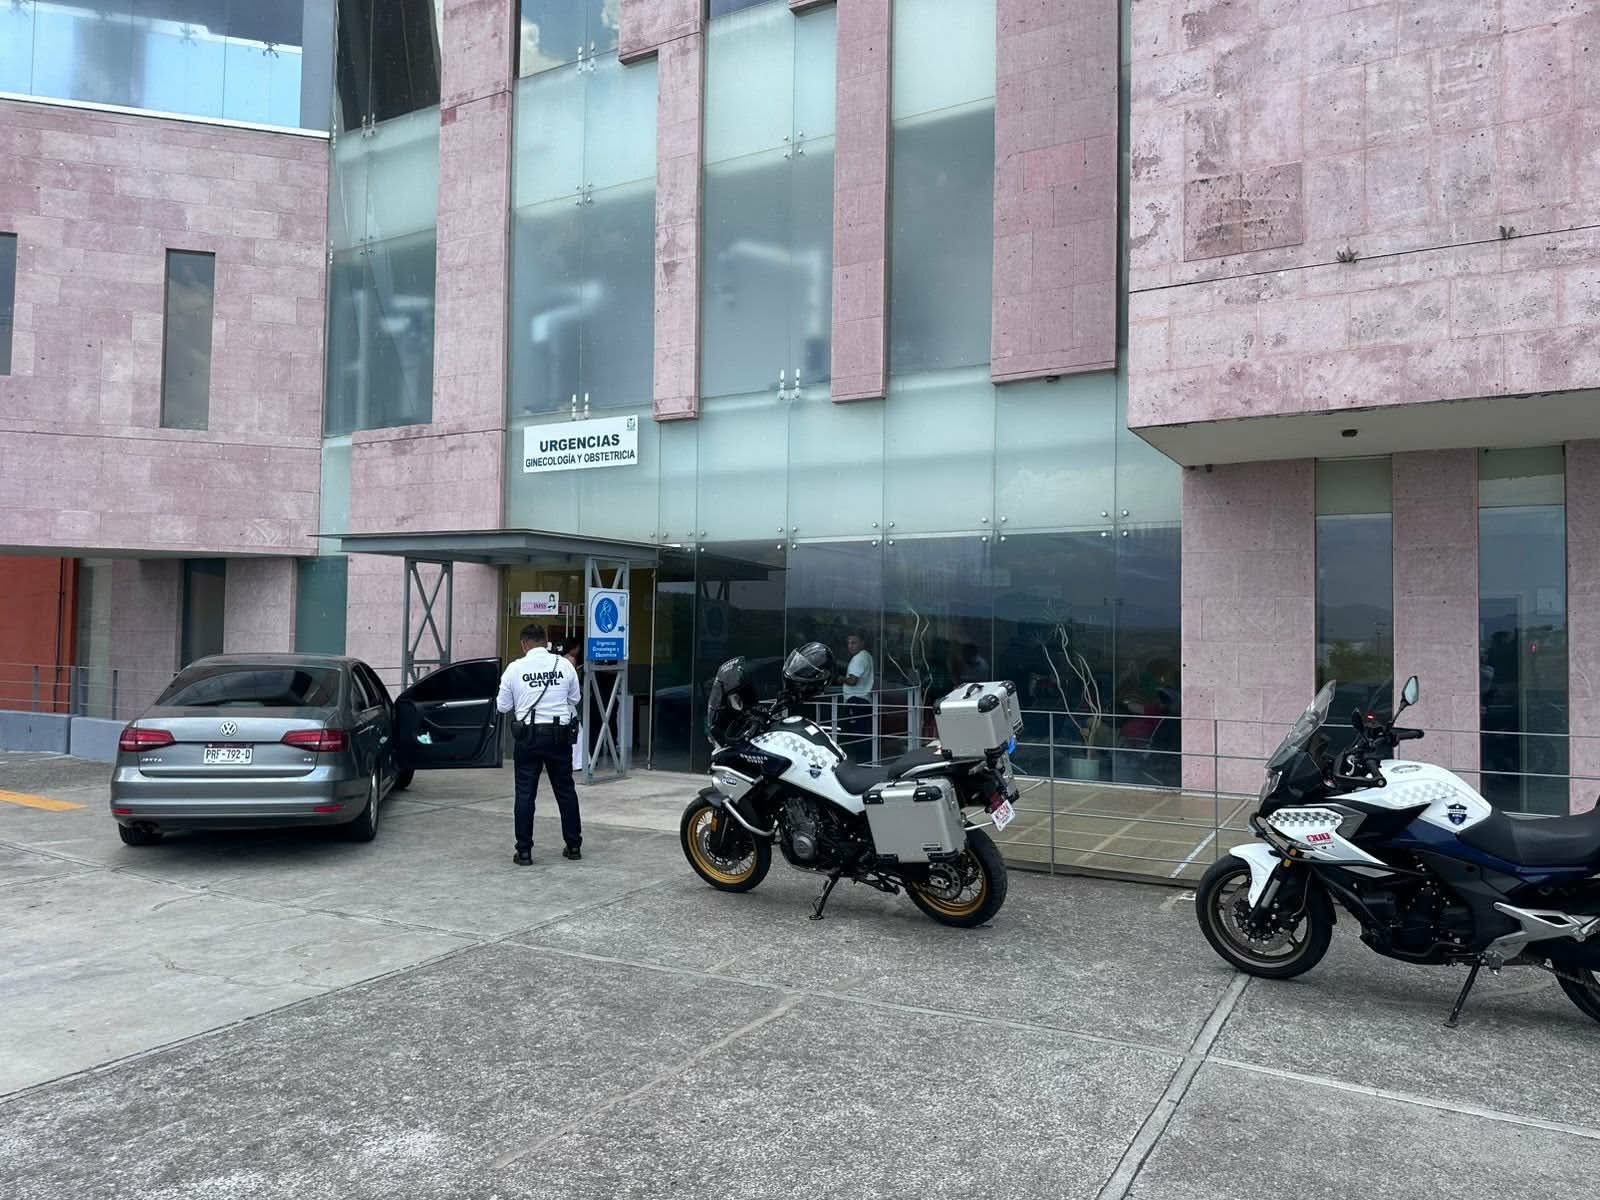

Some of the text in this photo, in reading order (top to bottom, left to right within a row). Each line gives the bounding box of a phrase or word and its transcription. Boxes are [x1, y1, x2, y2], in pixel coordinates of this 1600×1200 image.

[539, 433, 620, 453] URGENCIAS
[525, 449, 636, 468] GINECOLOGÍA Y OBSTETRICIA
[522, 671, 564, 682] GUARDIA
[529, 678, 560, 688] CIVIL
[206, 749, 251, 760] PRF-792-D
